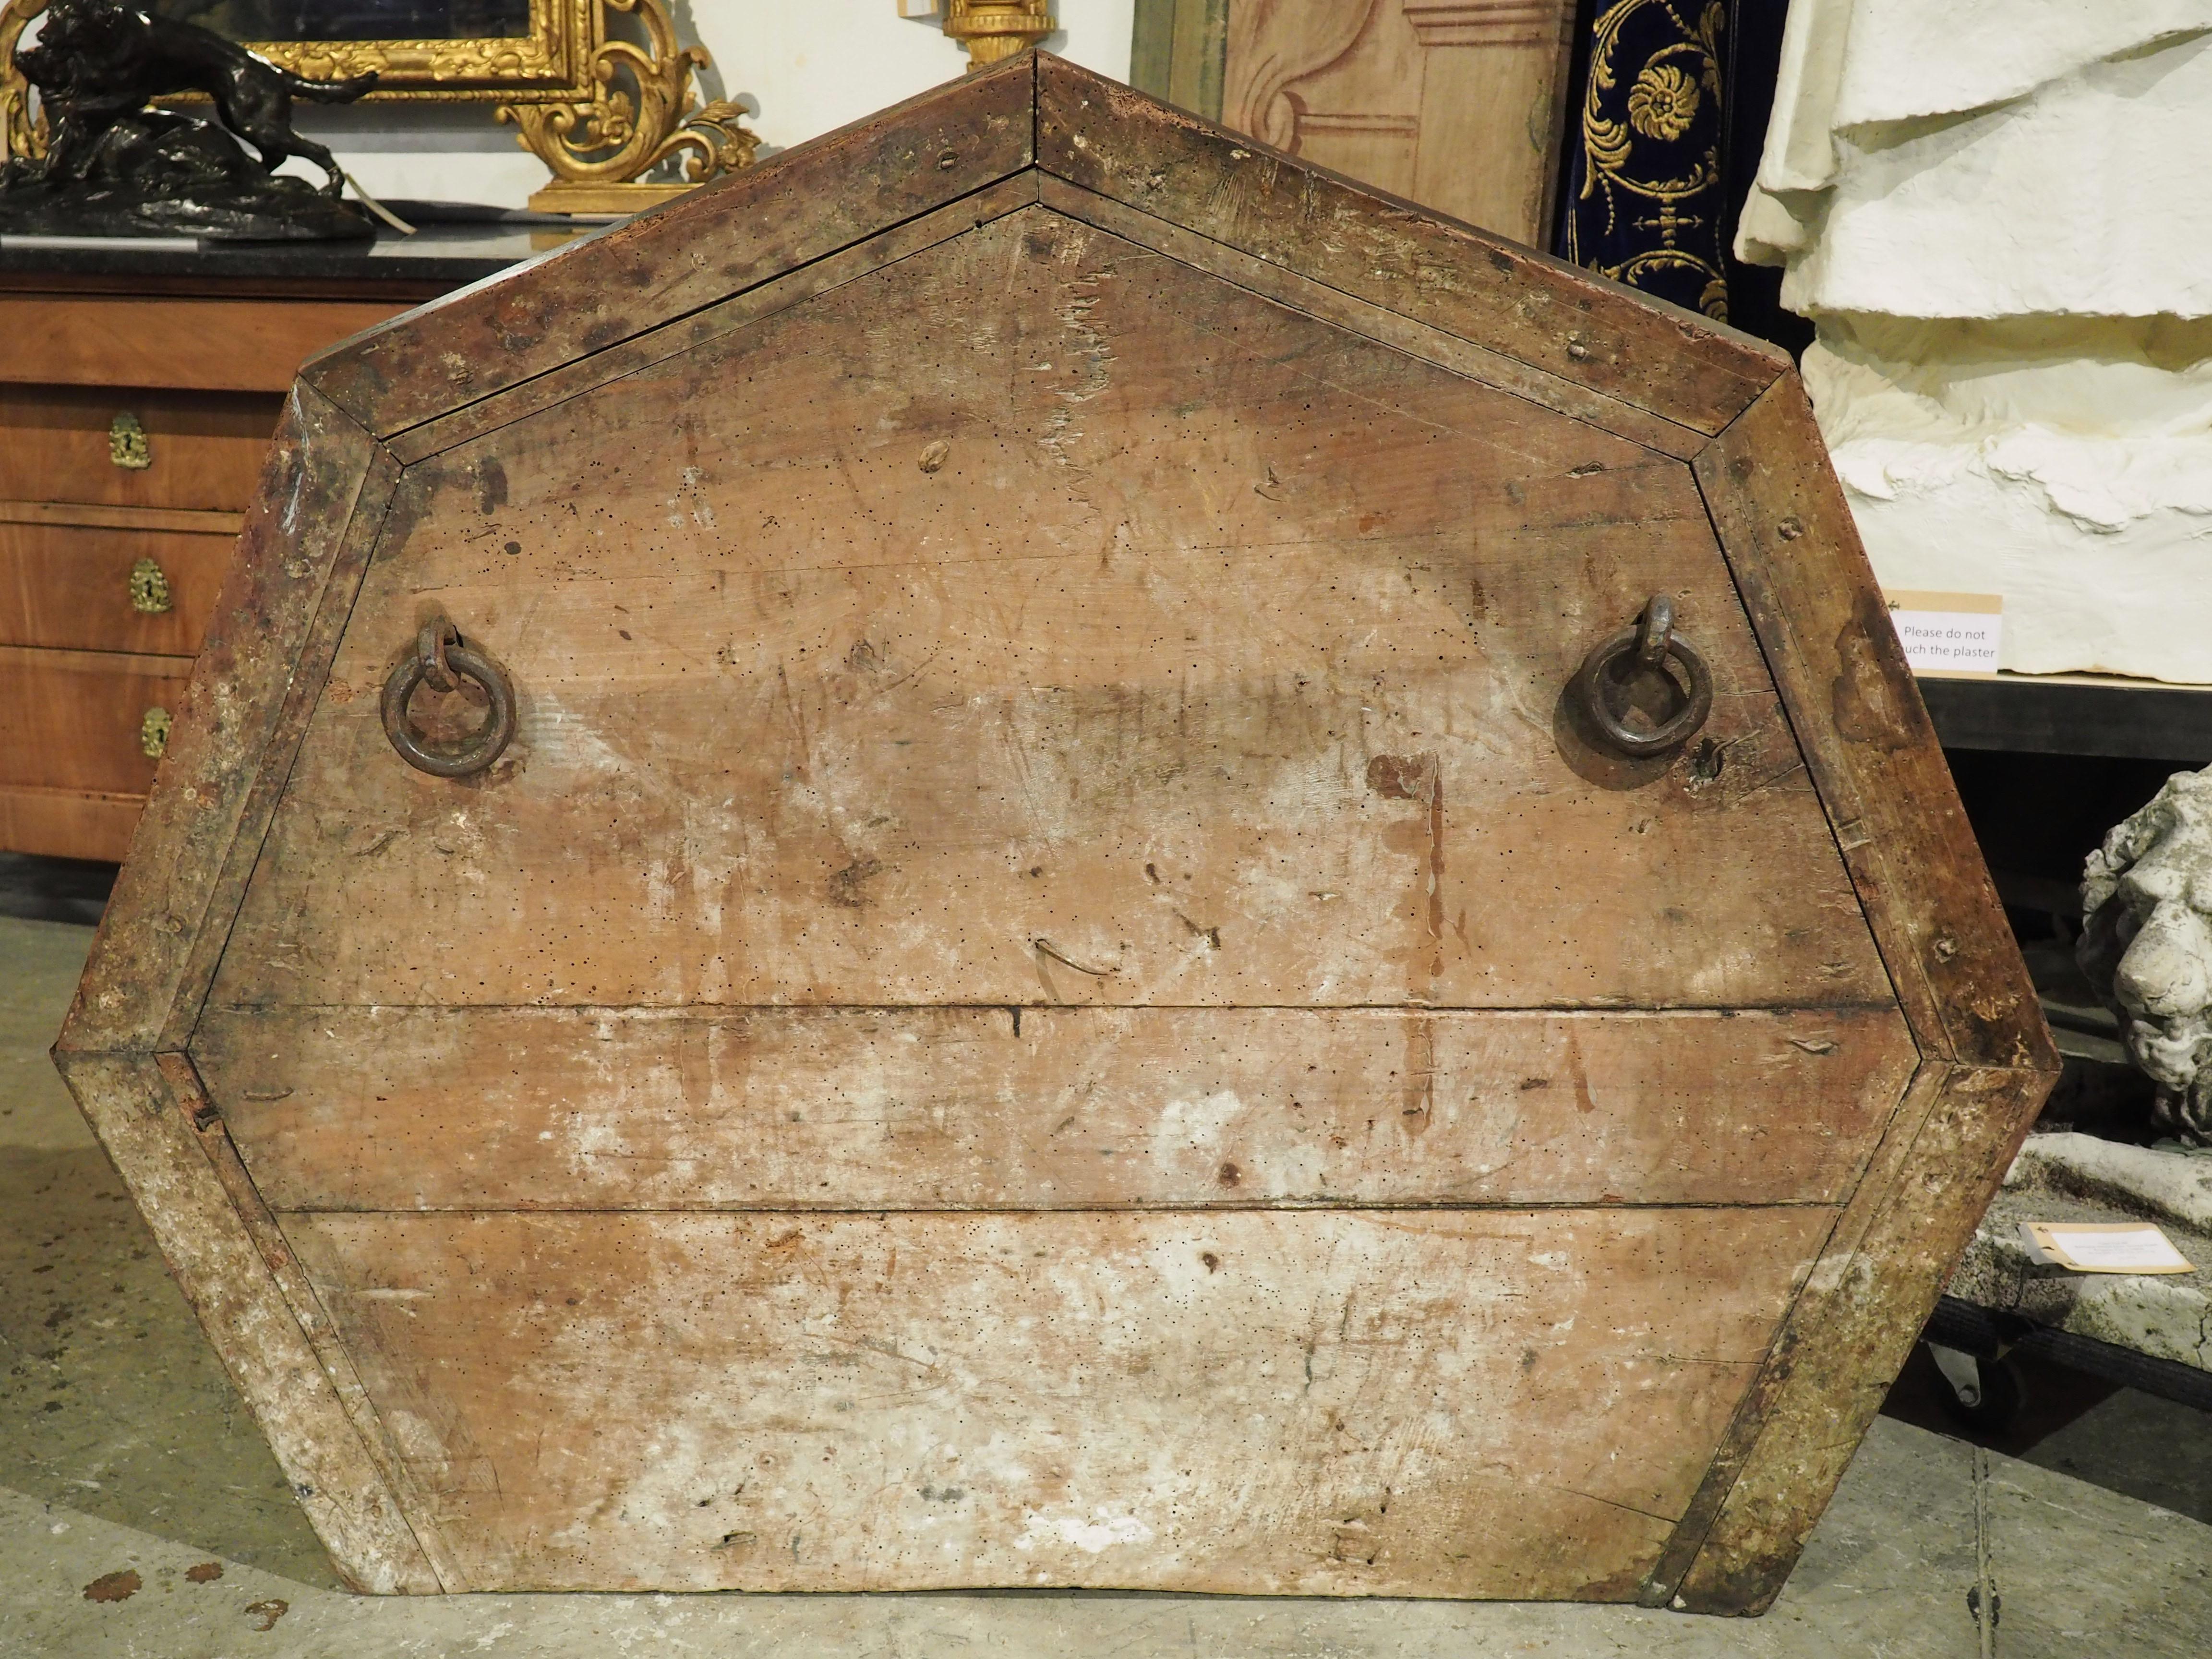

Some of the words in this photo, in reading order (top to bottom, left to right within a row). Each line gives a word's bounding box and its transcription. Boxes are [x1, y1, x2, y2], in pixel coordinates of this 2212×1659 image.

[1905, 626, 1942, 637] Please
[1946, 628, 1961, 638] do
[1966, 631, 1985, 639] not
[1906, 644, 1926, 654] uch
[1931, 645, 1949, 655] the
[1954, 646, 1995, 658] plaster
